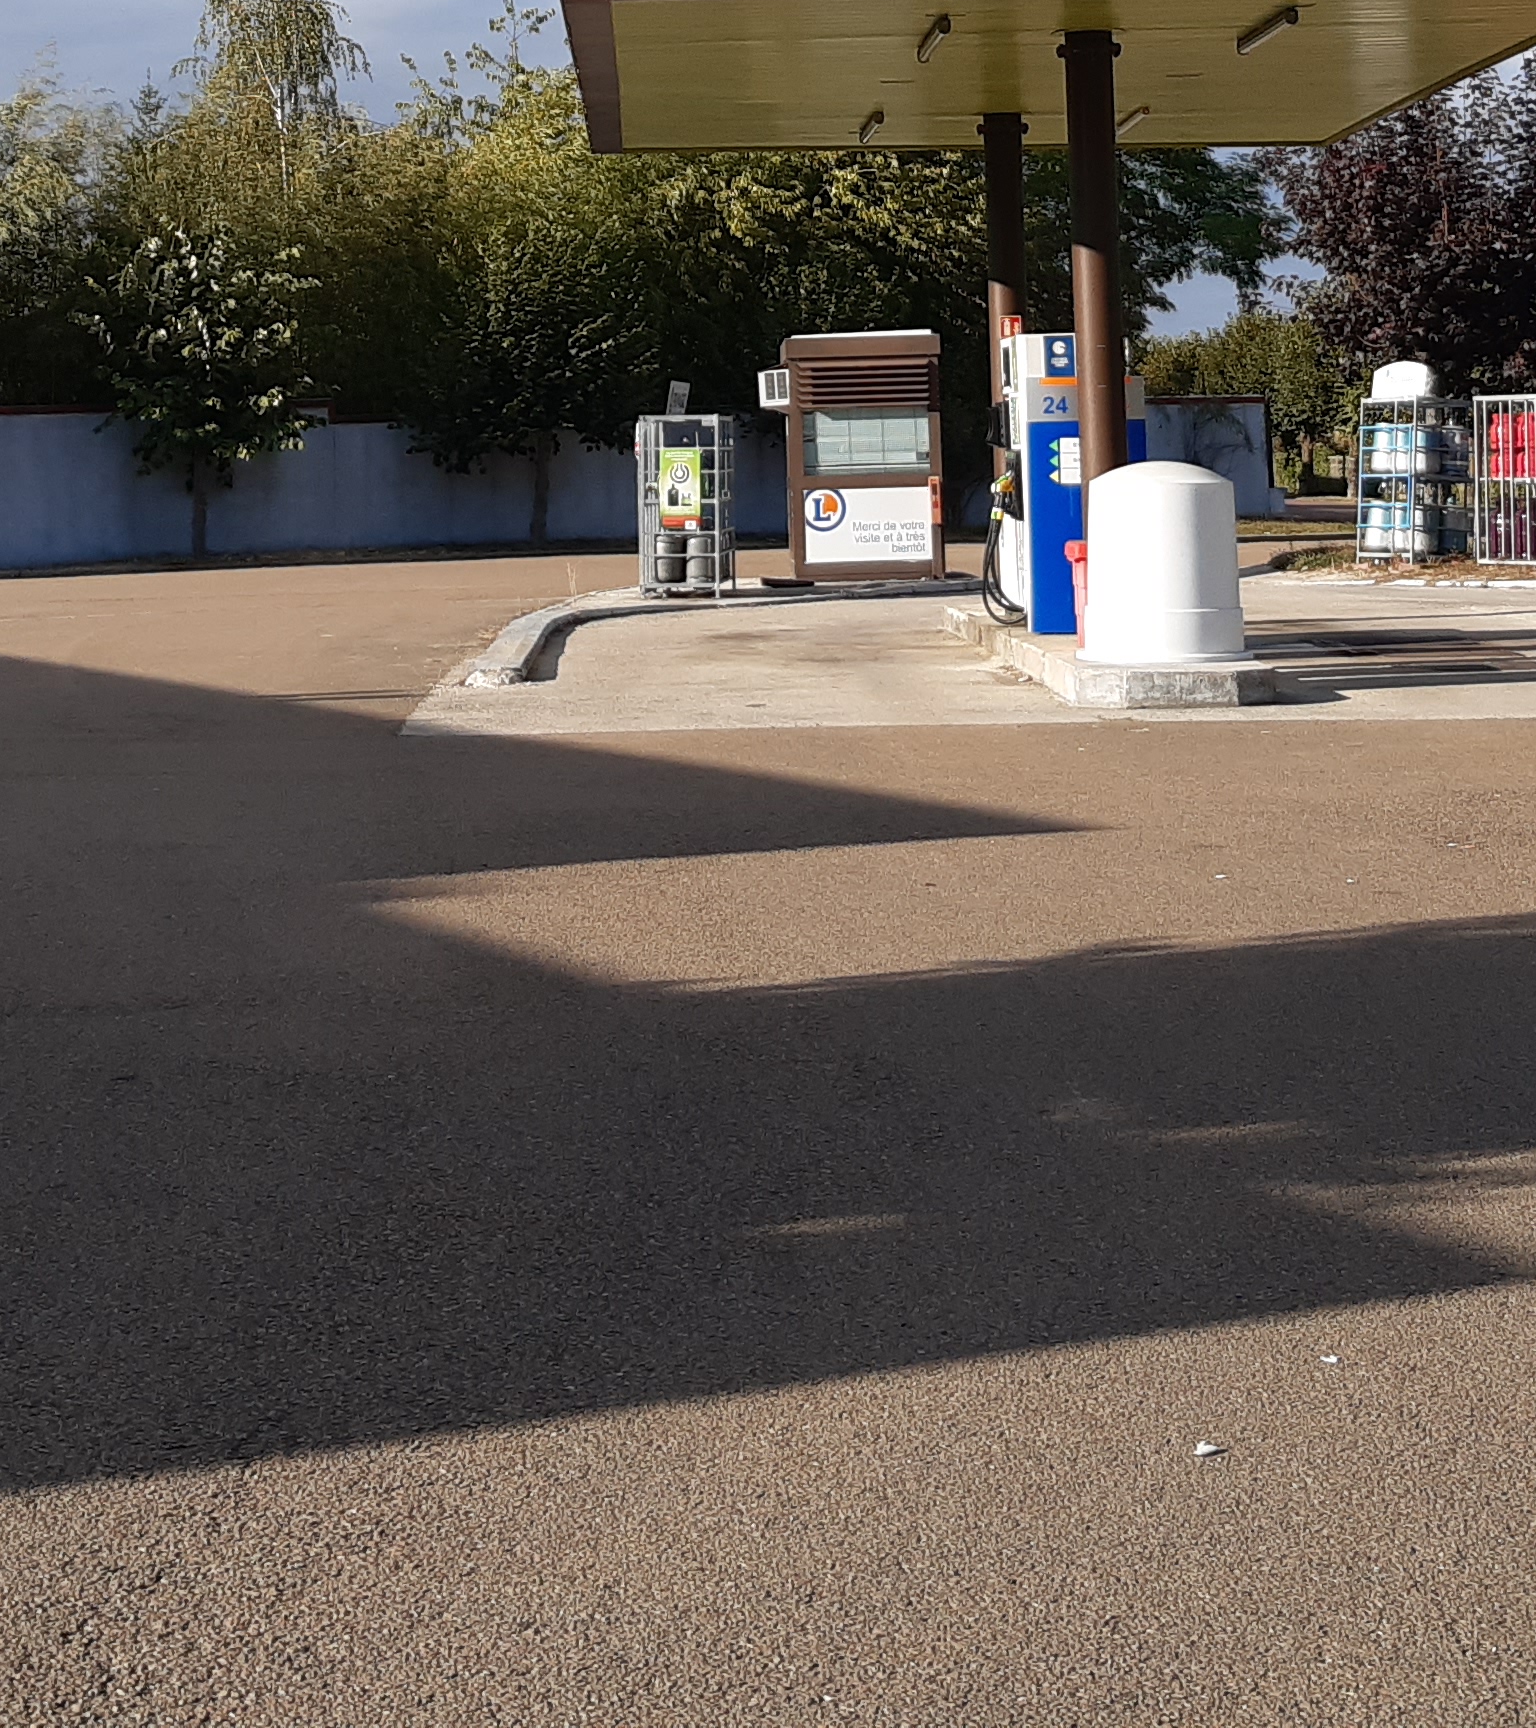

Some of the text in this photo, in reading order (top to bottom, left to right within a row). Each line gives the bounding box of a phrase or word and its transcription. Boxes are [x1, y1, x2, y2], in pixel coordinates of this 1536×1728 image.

[1041, 395, 1069, 415] 24
[852, 521, 925, 532] Merci de votre
[854, 532, 880, 543] visite
[883, 532, 893, 542] et
